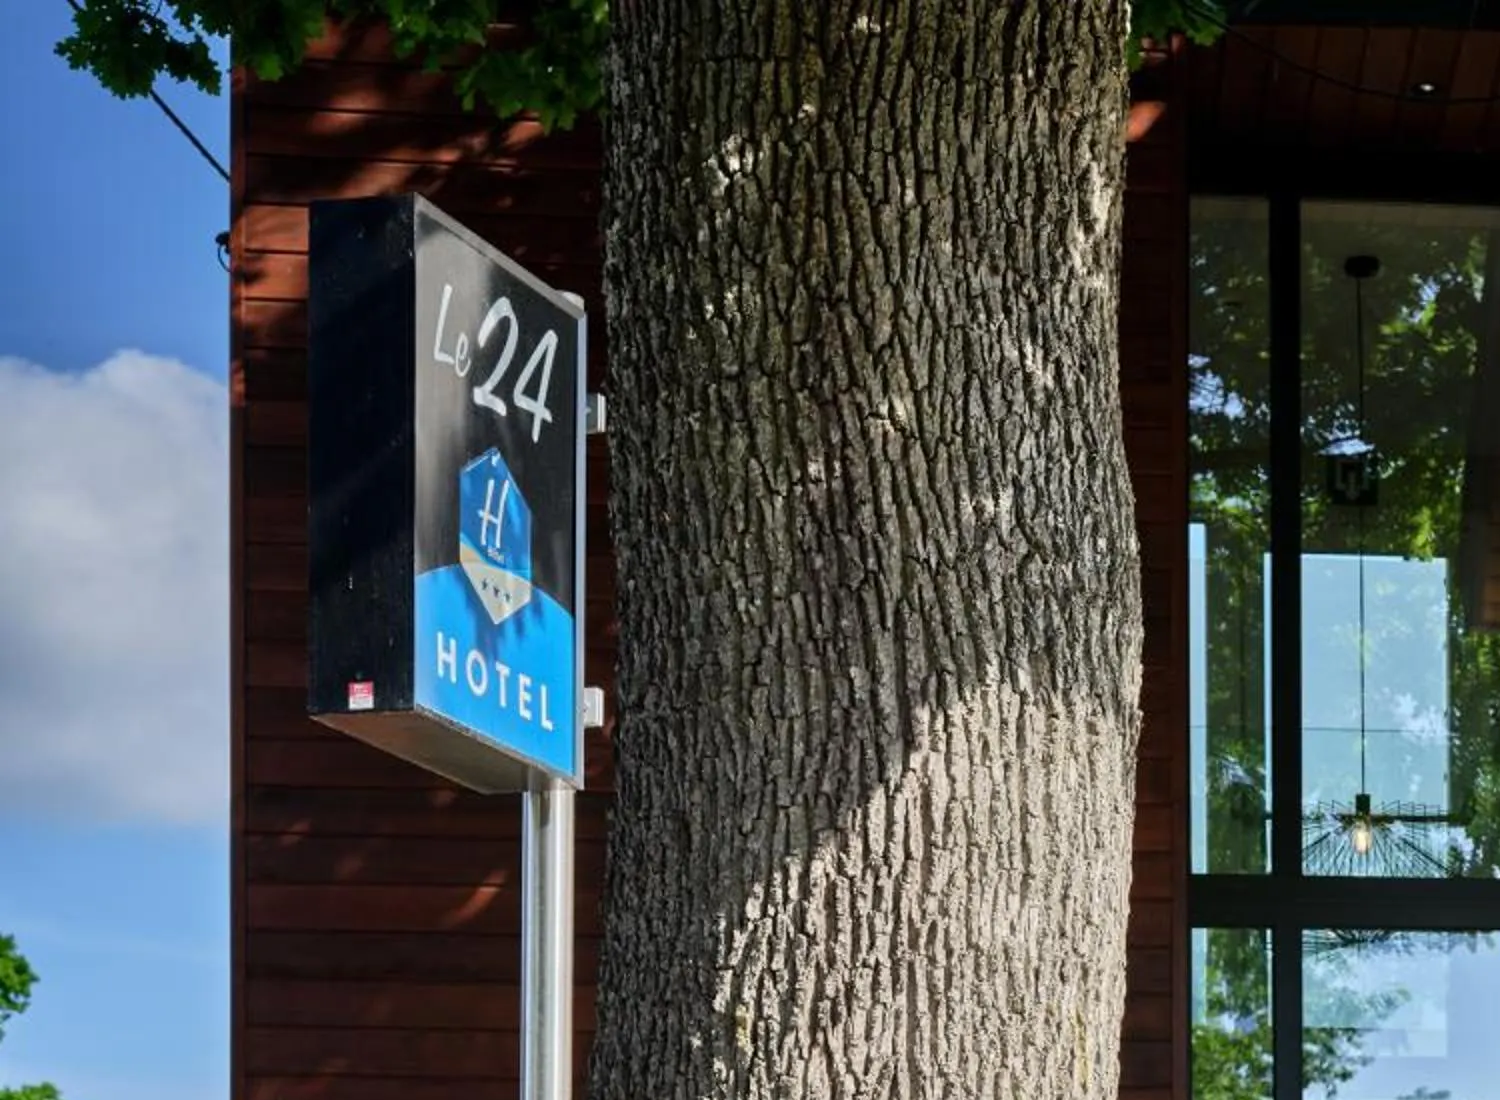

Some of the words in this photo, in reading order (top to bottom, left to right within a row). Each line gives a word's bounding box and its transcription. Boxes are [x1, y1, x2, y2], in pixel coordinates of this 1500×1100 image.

[434, 284, 471, 377] Le
[473, 296, 559, 444] 24
[478, 479, 510, 549] H
[437, 631, 554, 732] HOTEL
